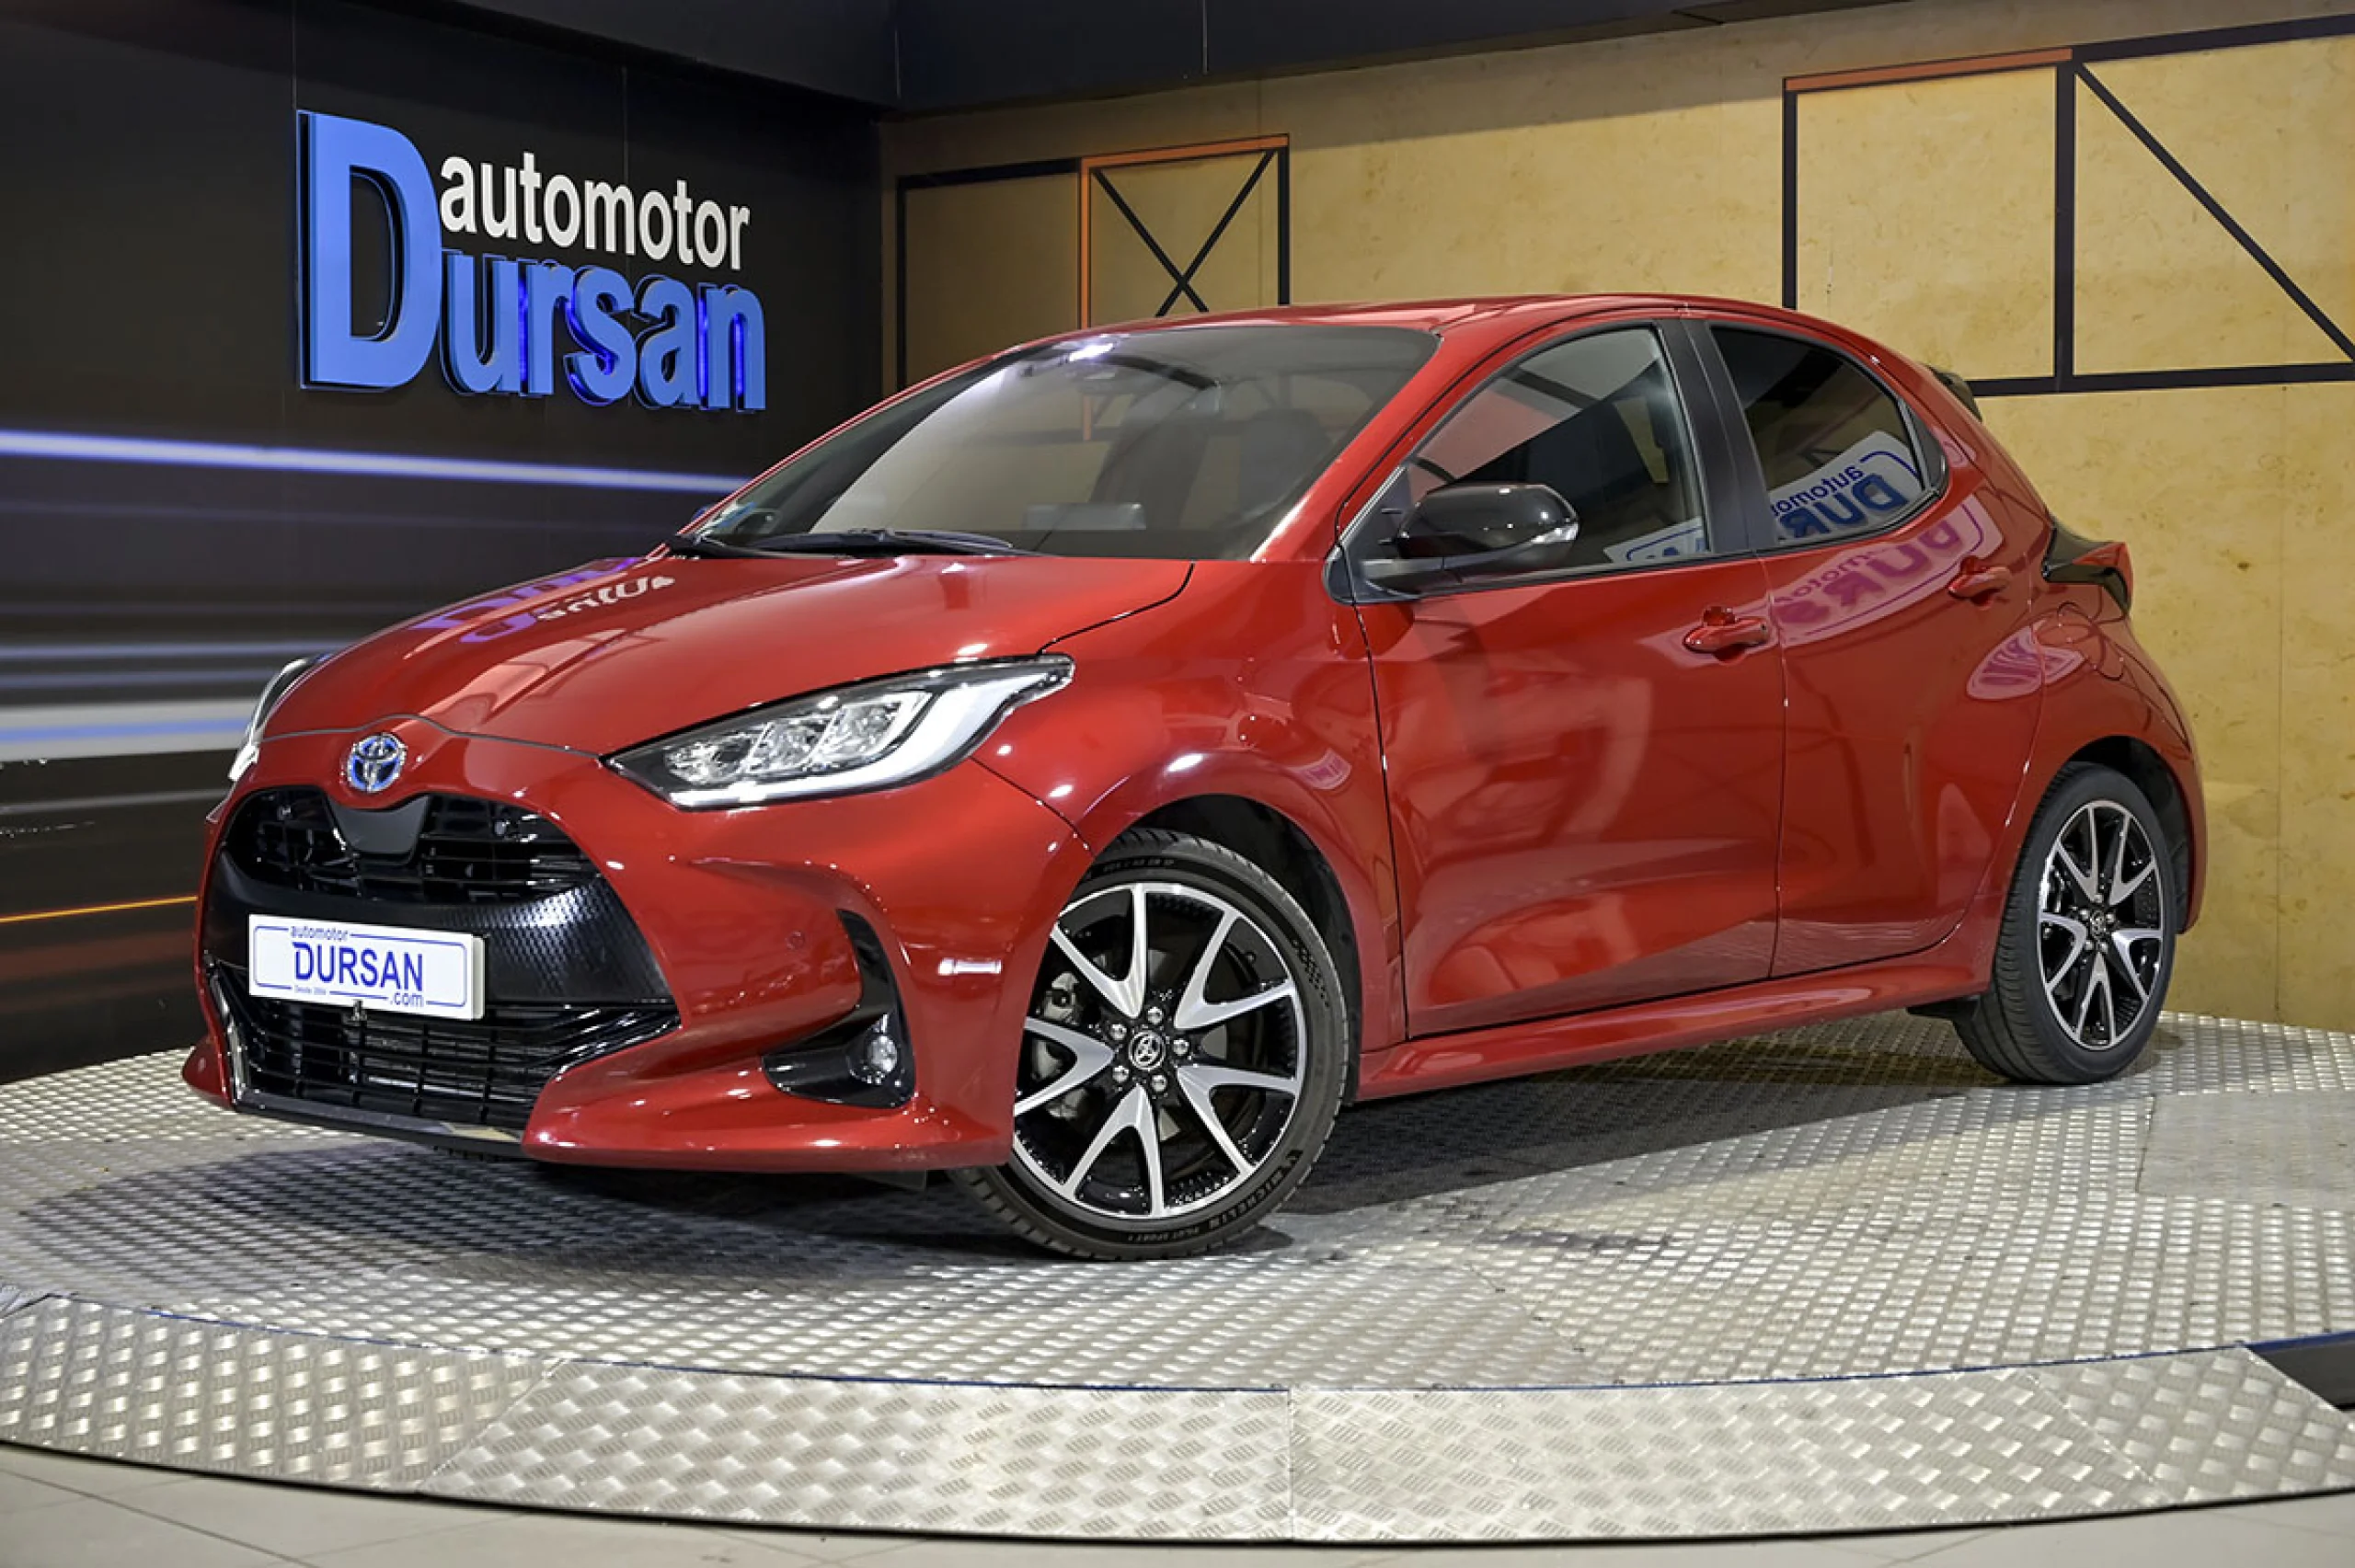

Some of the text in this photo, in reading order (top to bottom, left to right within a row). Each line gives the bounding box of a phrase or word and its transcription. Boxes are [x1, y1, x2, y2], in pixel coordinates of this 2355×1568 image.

[440, 152, 750, 269] automotor
[296, 109, 765, 413] Dursan
[291, 925, 349, 942] automotor
[293, 942, 423, 991] DURSAN
[390, 992, 424, 1007] .com
